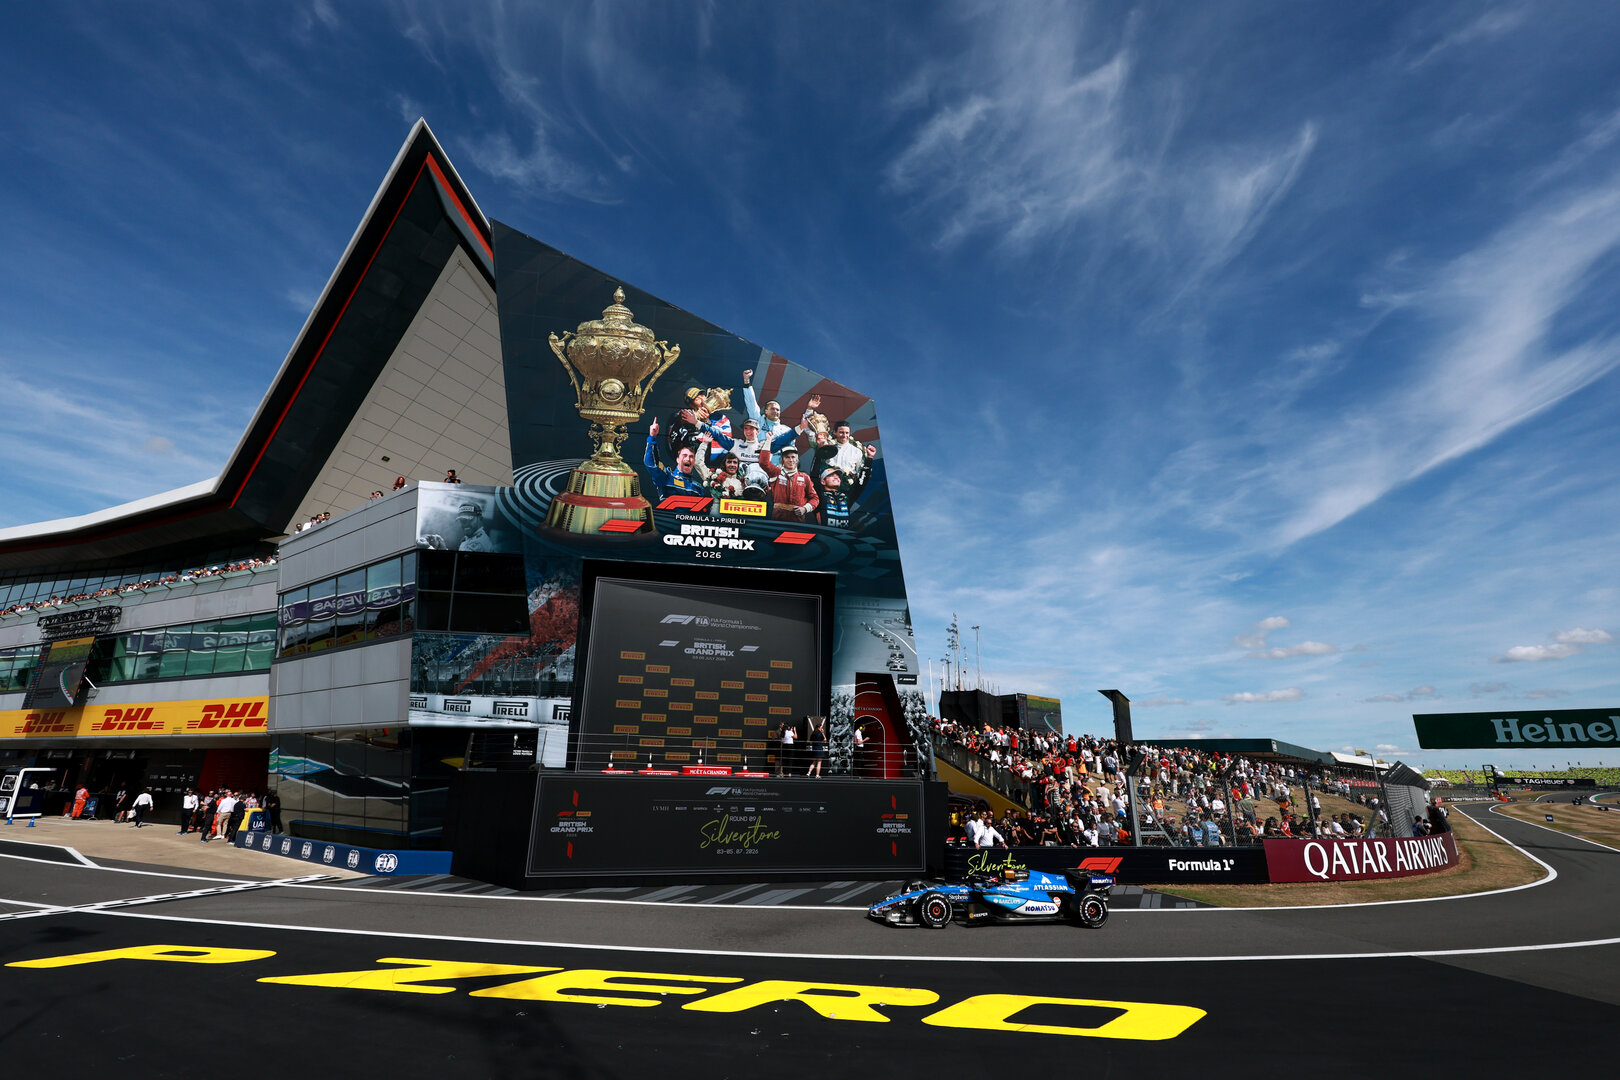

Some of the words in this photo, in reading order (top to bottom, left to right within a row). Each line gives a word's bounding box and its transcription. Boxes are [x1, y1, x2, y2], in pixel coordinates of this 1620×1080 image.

[724, 501, 763, 514] PIRELLI
[675, 514, 709, 523] FORMULA
[720, 517, 746, 525] PIRELLI
[680, 524, 739, 539] BRITISH
[663, 534, 717, 549] GRAND
[718, 538, 755, 551] PRIX
[695, 550, 722, 559] 2026
[695, 617, 710, 625] FIA
[684, 648, 714, 656] GRAND
[714, 649, 735, 657] PRIX
[693, 642, 726, 650] BRITISH
[409, 696, 428, 708] RELLI
[444, 698, 471, 713] PIRELLI
[493, 701, 529, 717] PIRELLI
[22, 712, 66, 733] DHL
[100, 707, 155, 731] DHL
[198, 702, 266, 729] DHL
[700, 814, 782, 849] Silverstone
[302, 843, 312, 857] FIA
[323, 847, 335, 861] FIA
[347, 851, 359, 866] FIA
[375, 855, 398, 871] FIA
[1168, 858, 1221, 871] Formula
[1303, 841, 1393, 879] QATAR
[1395, 836, 1449, 872] AIRWAYS
[1033, 884, 1068, 892] ATLASSIAN
[1025, 904, 1056, 912] KOMATSU
[5, 945, 277, 968] P
[256, 958, 1207, 1040] ZERO
